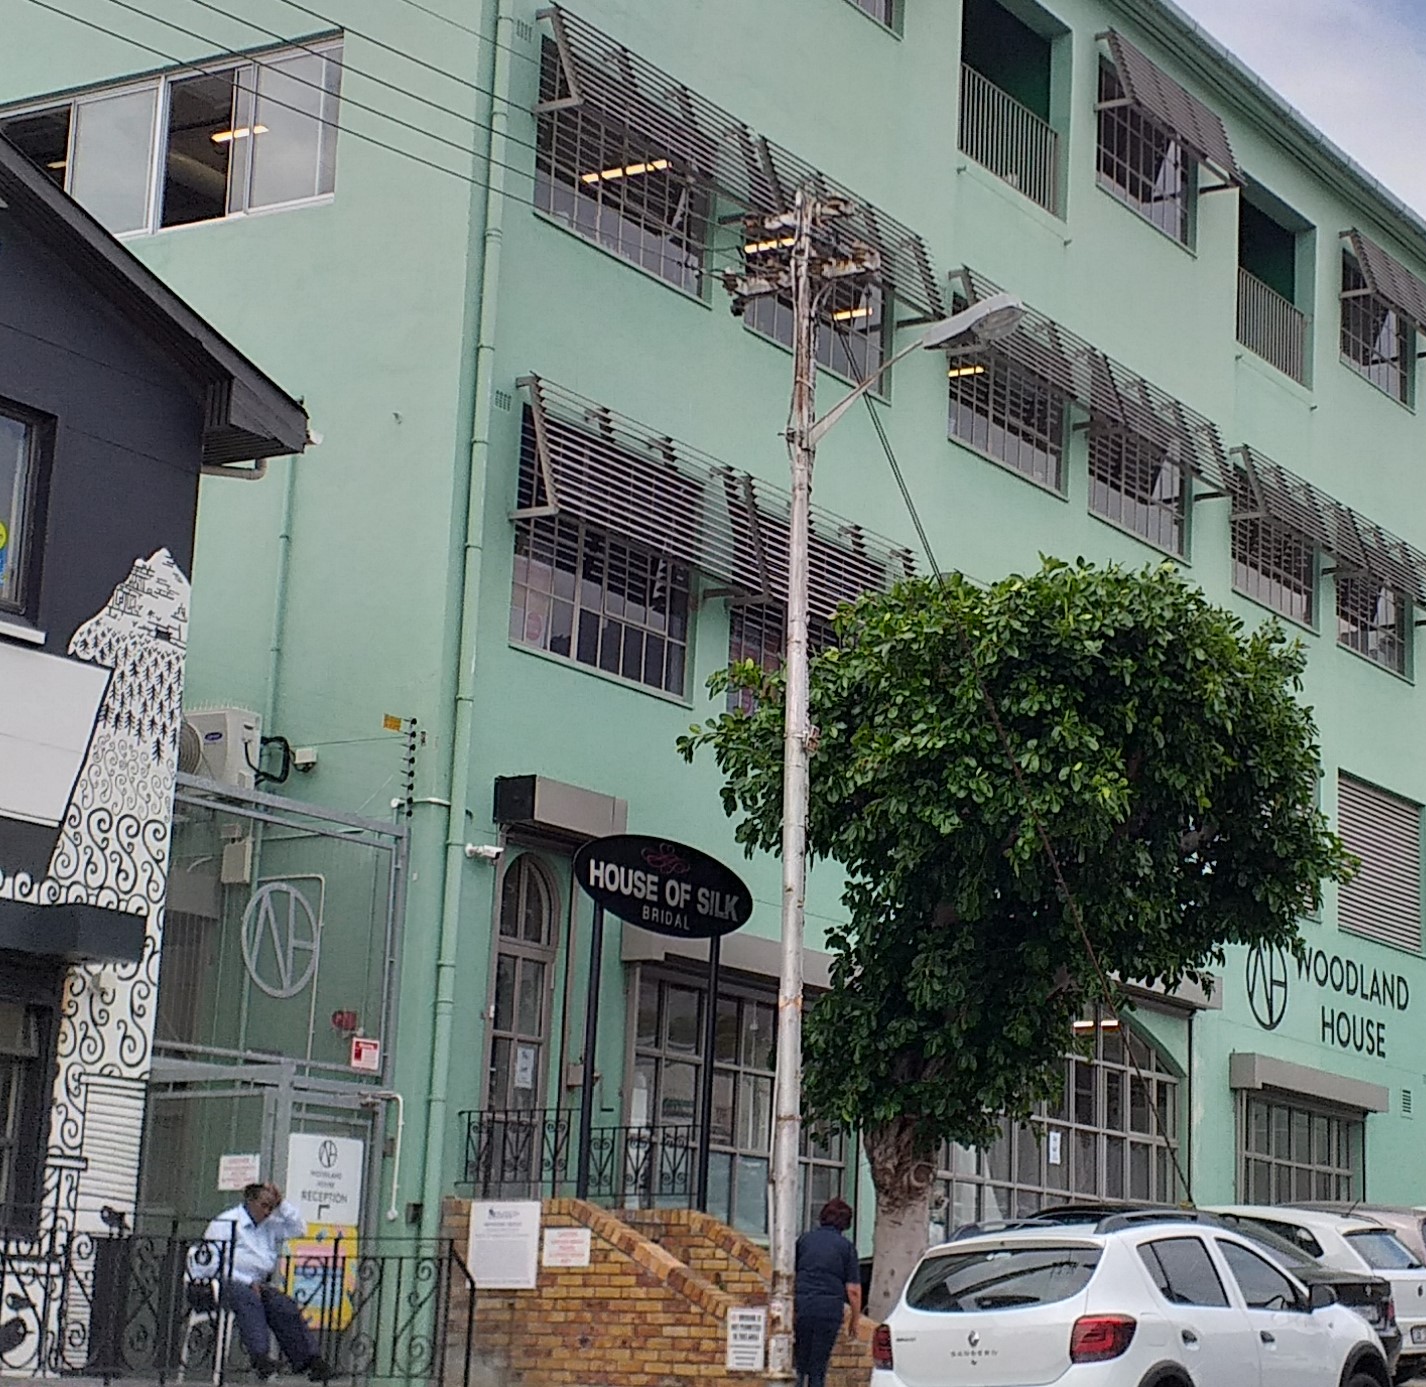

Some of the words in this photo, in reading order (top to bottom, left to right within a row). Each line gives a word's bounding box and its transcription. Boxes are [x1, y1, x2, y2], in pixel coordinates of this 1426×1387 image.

[589, 858, 660, 902] HOUSE
[665, 879, 692, 909] OF
[697, 887, 740, 922] SILK
[642, 905, 690, 931] BRIDAL
[1295, 946, 1409, 1011] WOODLAND
[1321, 1005, 1386, 1059] HOUSE
[301, 1190, 347, 1204] RECEPTION
